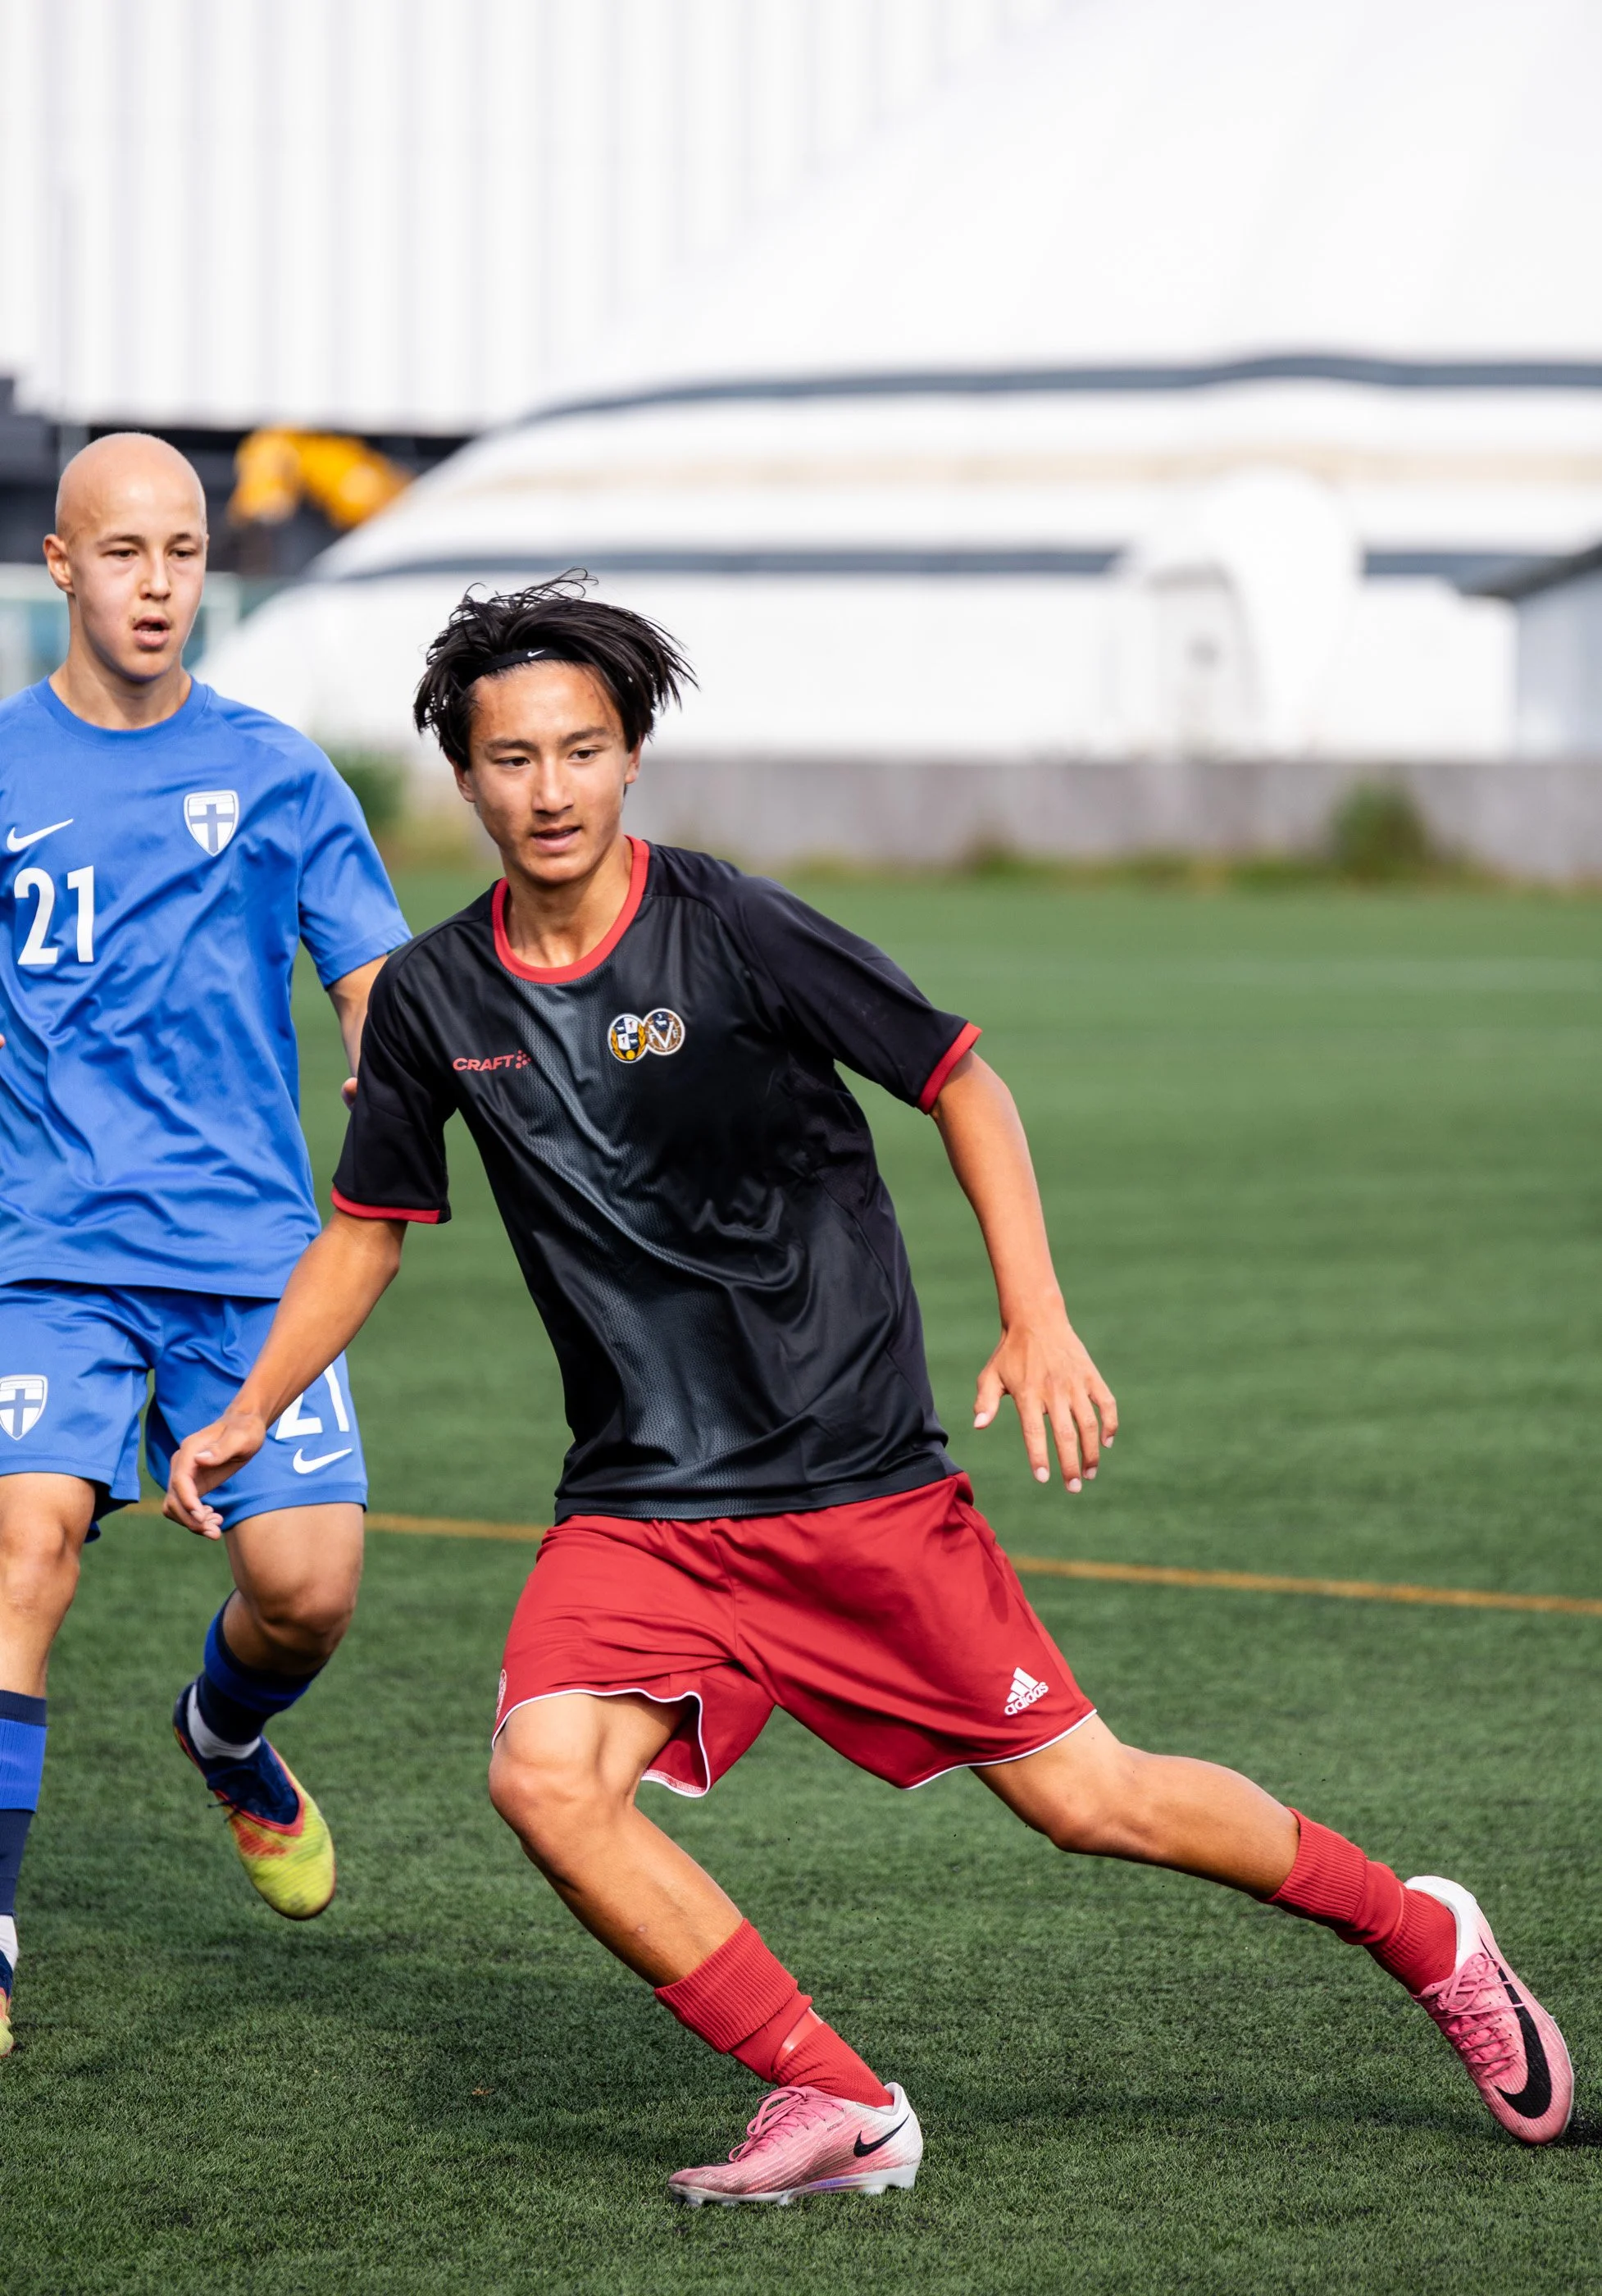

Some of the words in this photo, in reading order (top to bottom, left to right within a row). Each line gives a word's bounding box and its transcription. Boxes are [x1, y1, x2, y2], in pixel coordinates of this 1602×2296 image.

[14, 865, 94, 965] 21
[453, 1054, 515, 1072] CRAFT
[1004, 1681, 1049, 1715] adidas
